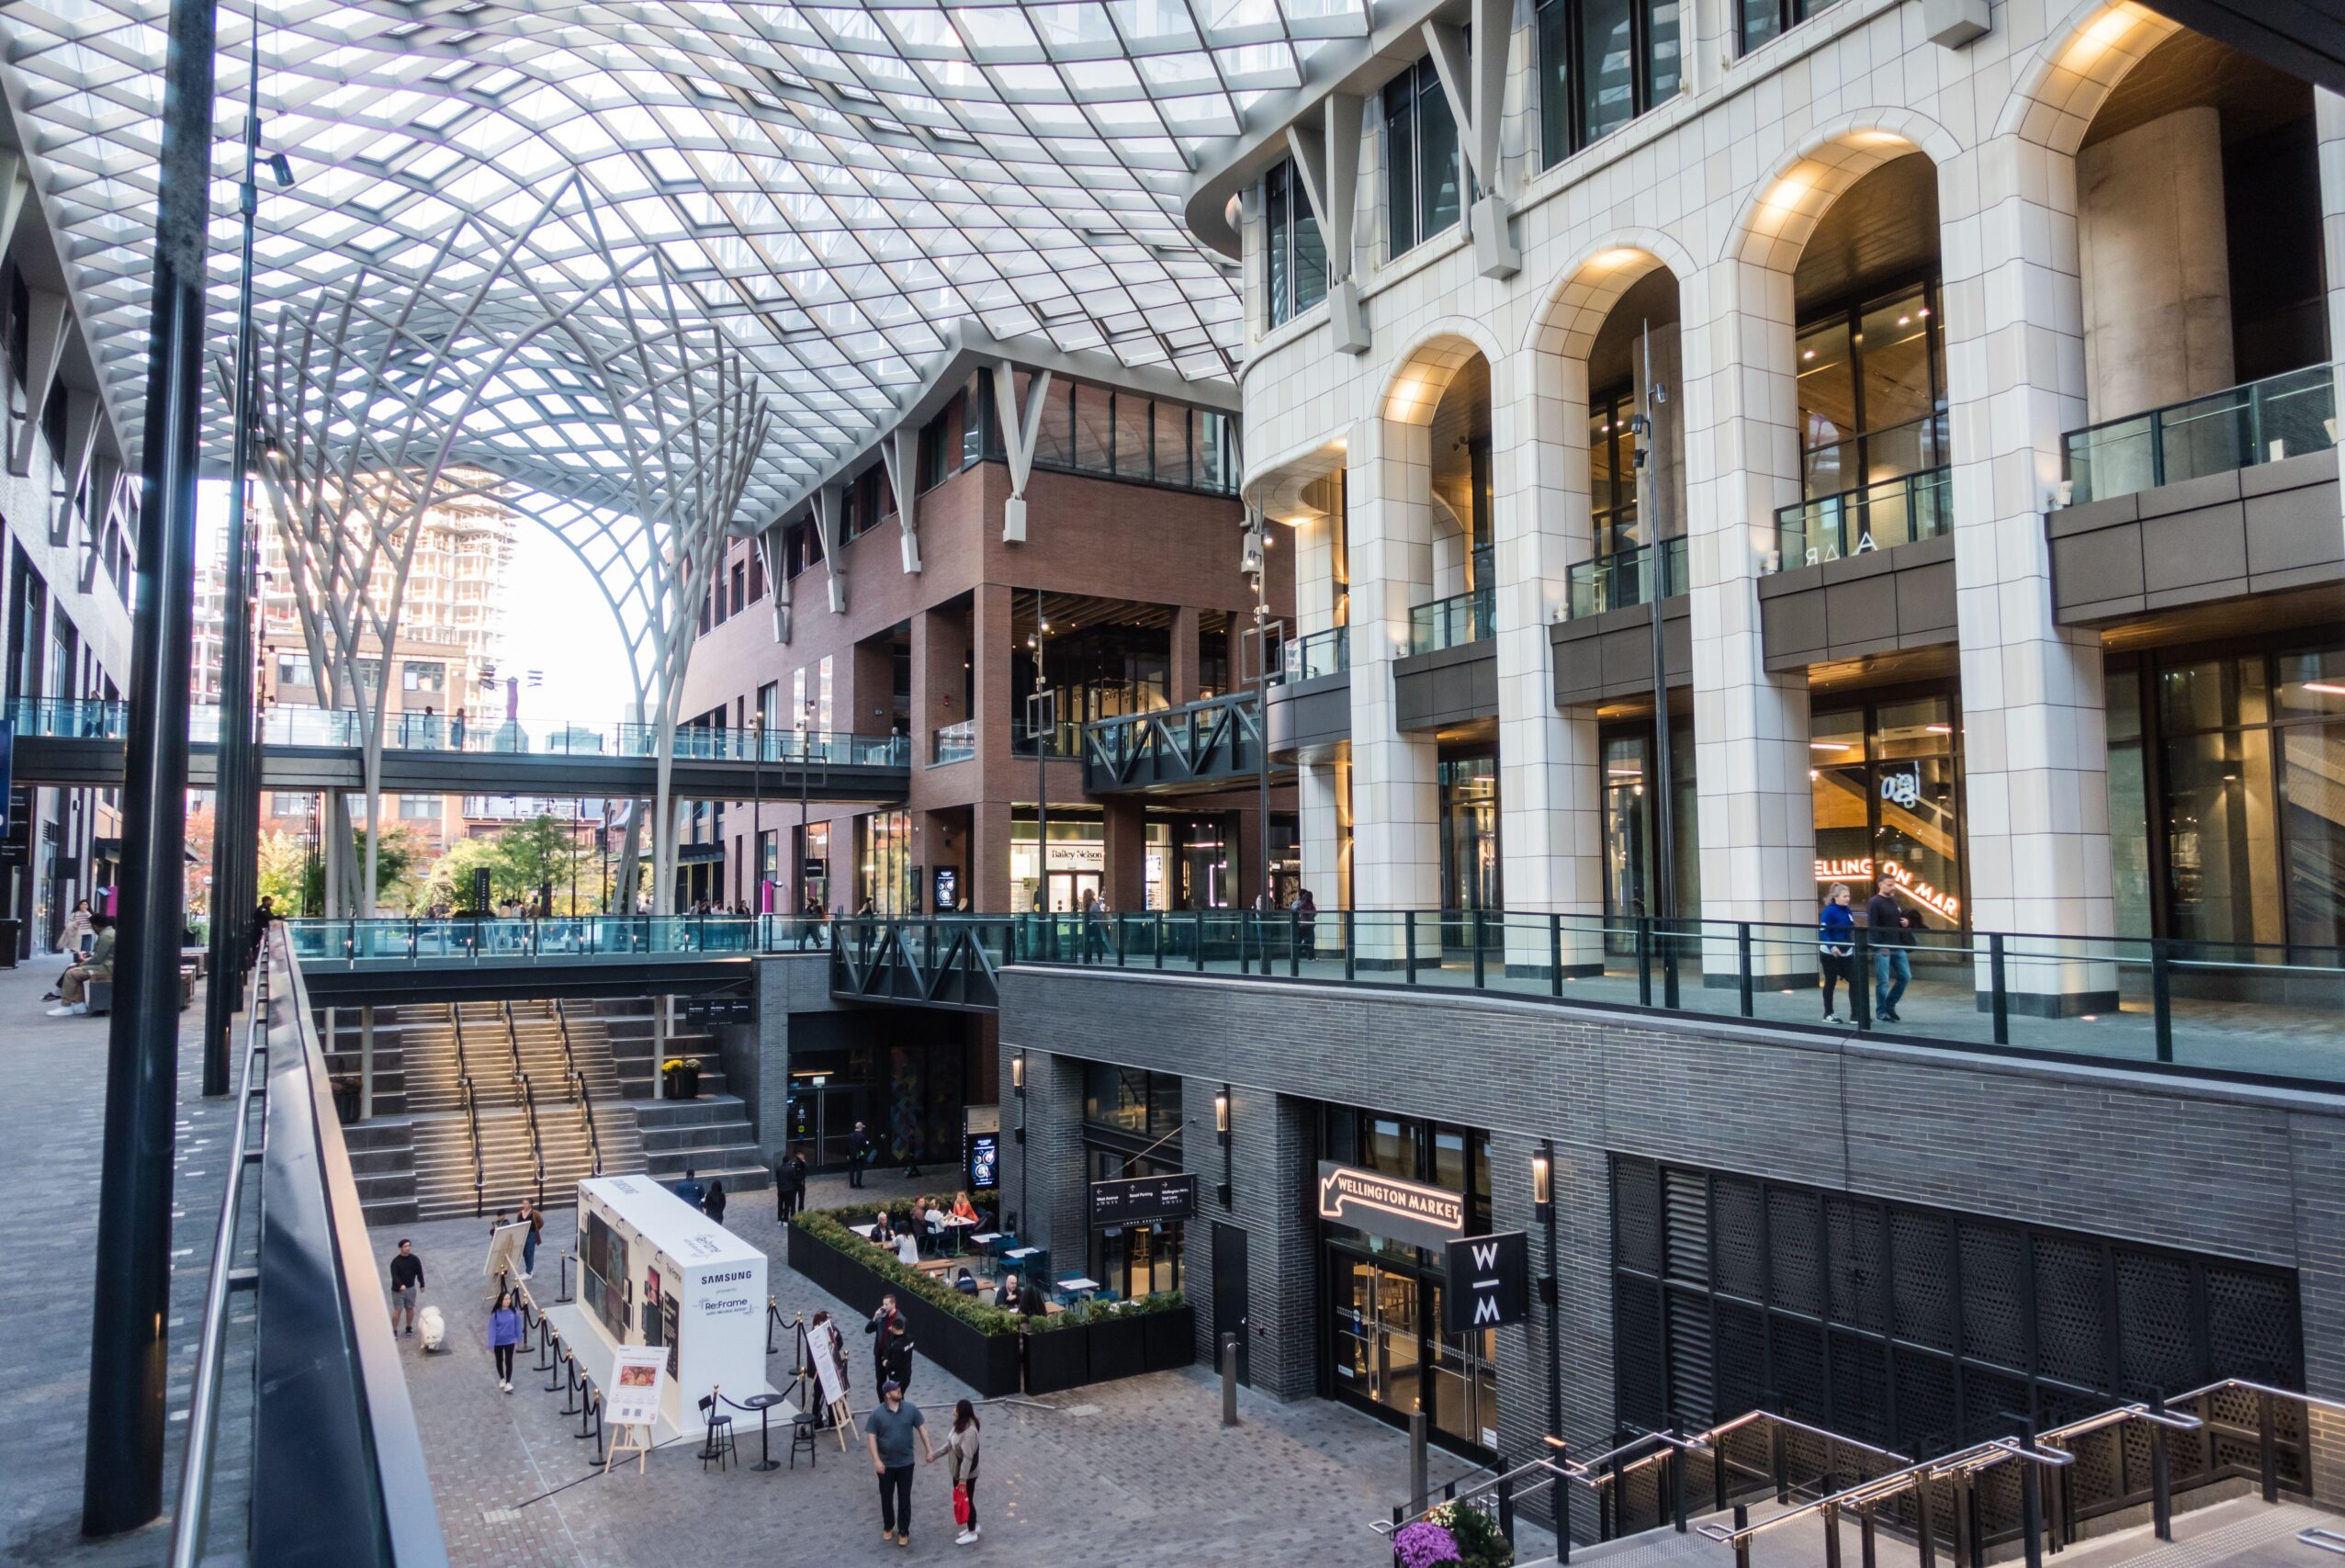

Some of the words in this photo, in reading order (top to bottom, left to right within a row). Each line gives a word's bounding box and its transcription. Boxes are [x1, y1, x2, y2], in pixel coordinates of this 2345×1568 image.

[1338, 1177, 1406, 1208] WELLINGTON
[1408, 1195, 1460, 1220] MARKET
[1471, 1242, 1498, 1271] W
[701, 1270, 752, 1285] SAMSUNG
[705, 1298, 749, 1311] Re:Frame
[1473, 1295, 1501, 1325] M
